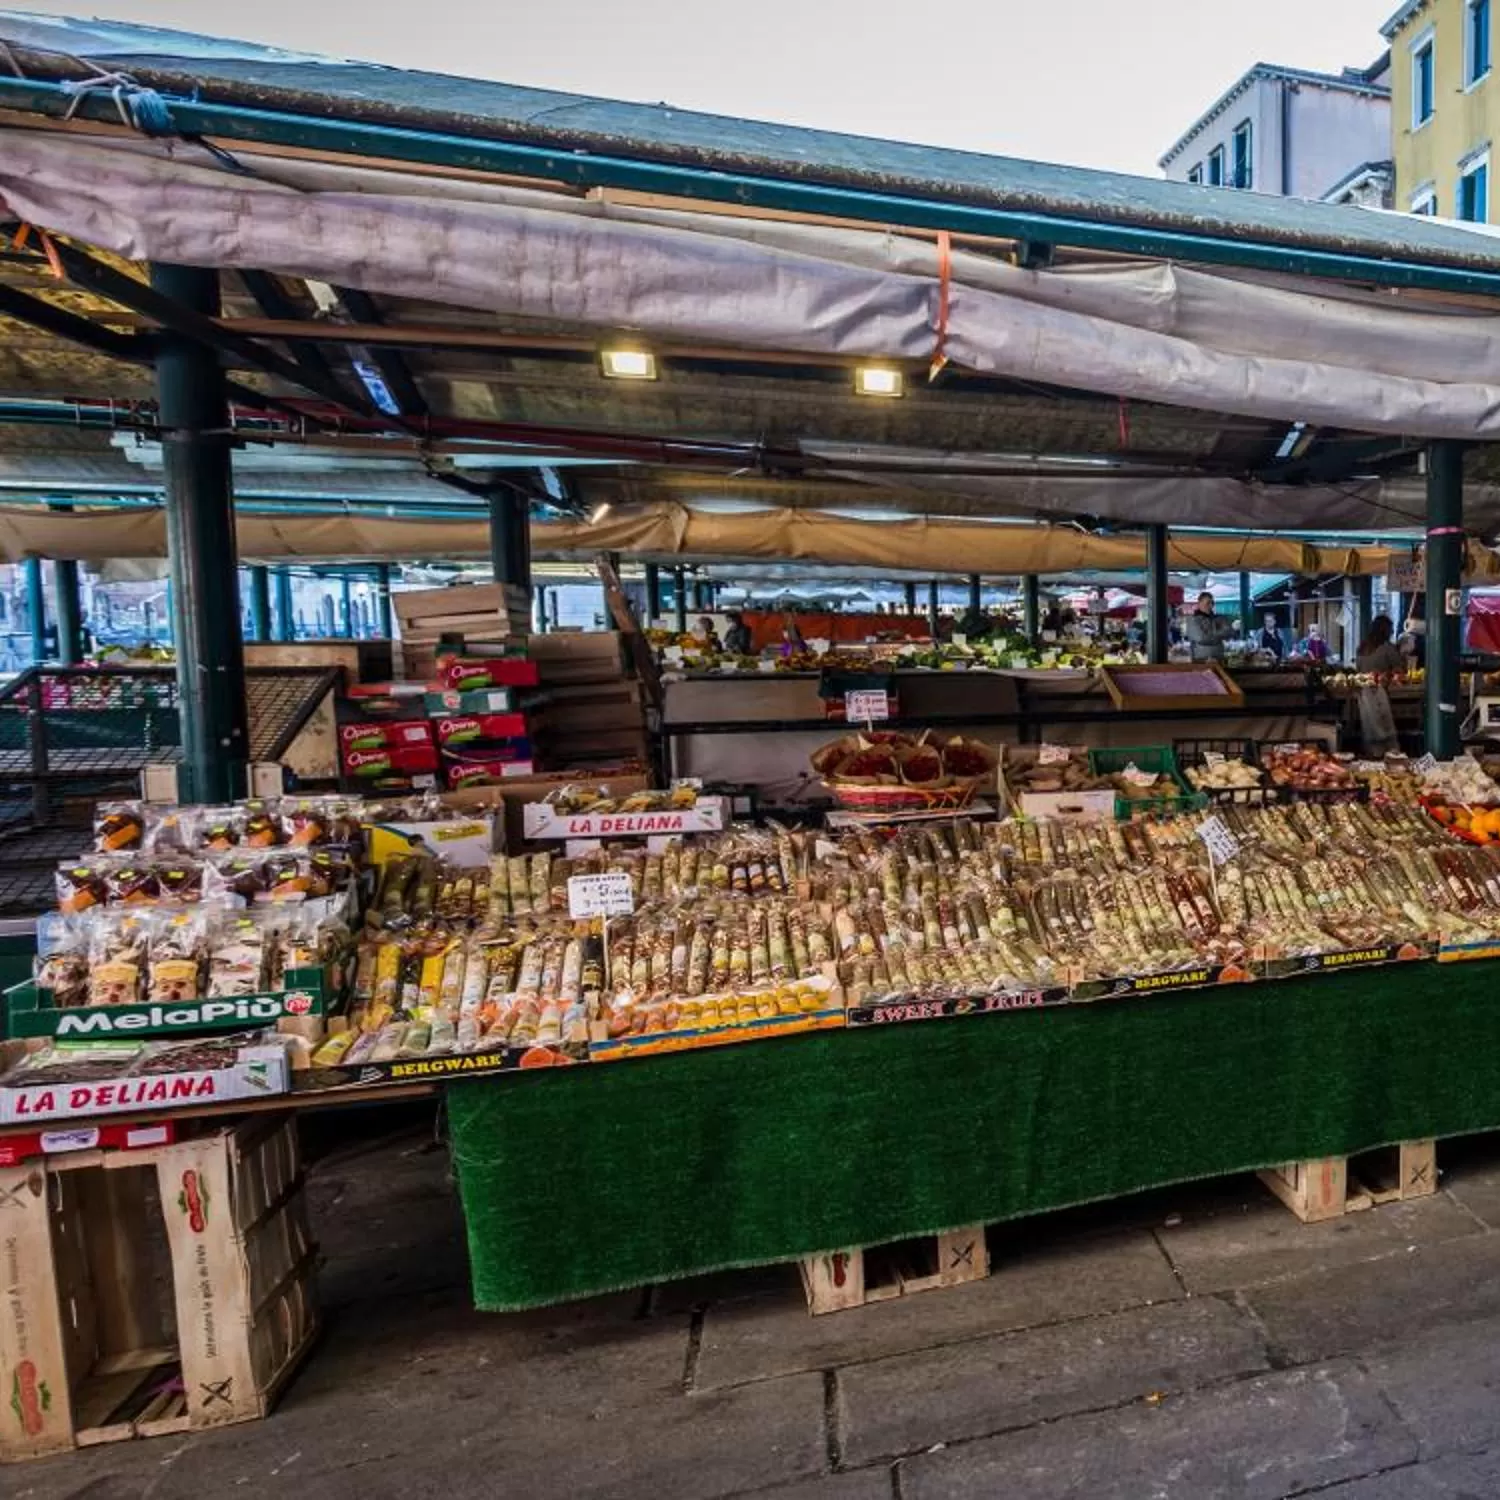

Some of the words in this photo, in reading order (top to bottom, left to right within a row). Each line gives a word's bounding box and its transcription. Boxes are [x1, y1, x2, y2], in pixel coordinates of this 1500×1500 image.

[569, 819, 592, 833] LA
[600, 815, 684, 833] DELIANA
[55, 998, 283, 1036] MelaPiù
[873, 1002, 945, 1023] SWEET
[391, 1055, 503, 1077] BERGWARE
[15, 1091, 56, 1115] LA
[69, 1075, 216, 1110] DELIANA
